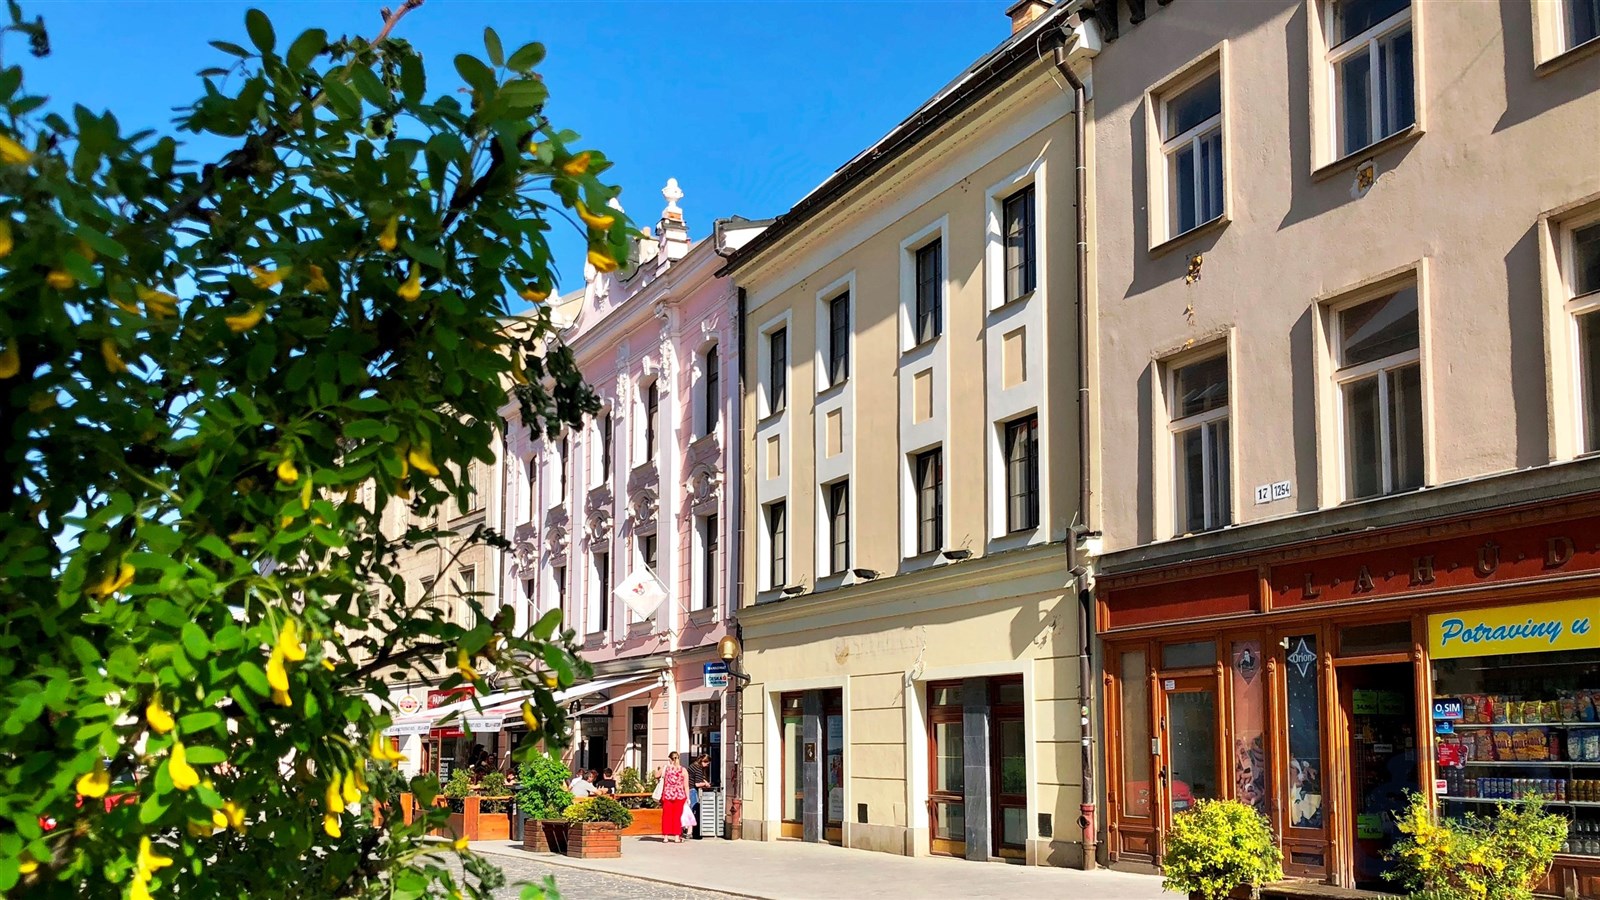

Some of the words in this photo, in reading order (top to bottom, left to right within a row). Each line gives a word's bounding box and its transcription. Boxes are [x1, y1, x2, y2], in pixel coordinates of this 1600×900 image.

[1258, 487, 1268, 500] 17
[1274, 483, 1290, 497] 1254
[1440, 616, 1563, 647] Potraviny
[1571, 616, 1591, 635] u
[1293, 652, 1313, 663] Orion
[1444, 703, 1460, 713] SIM
